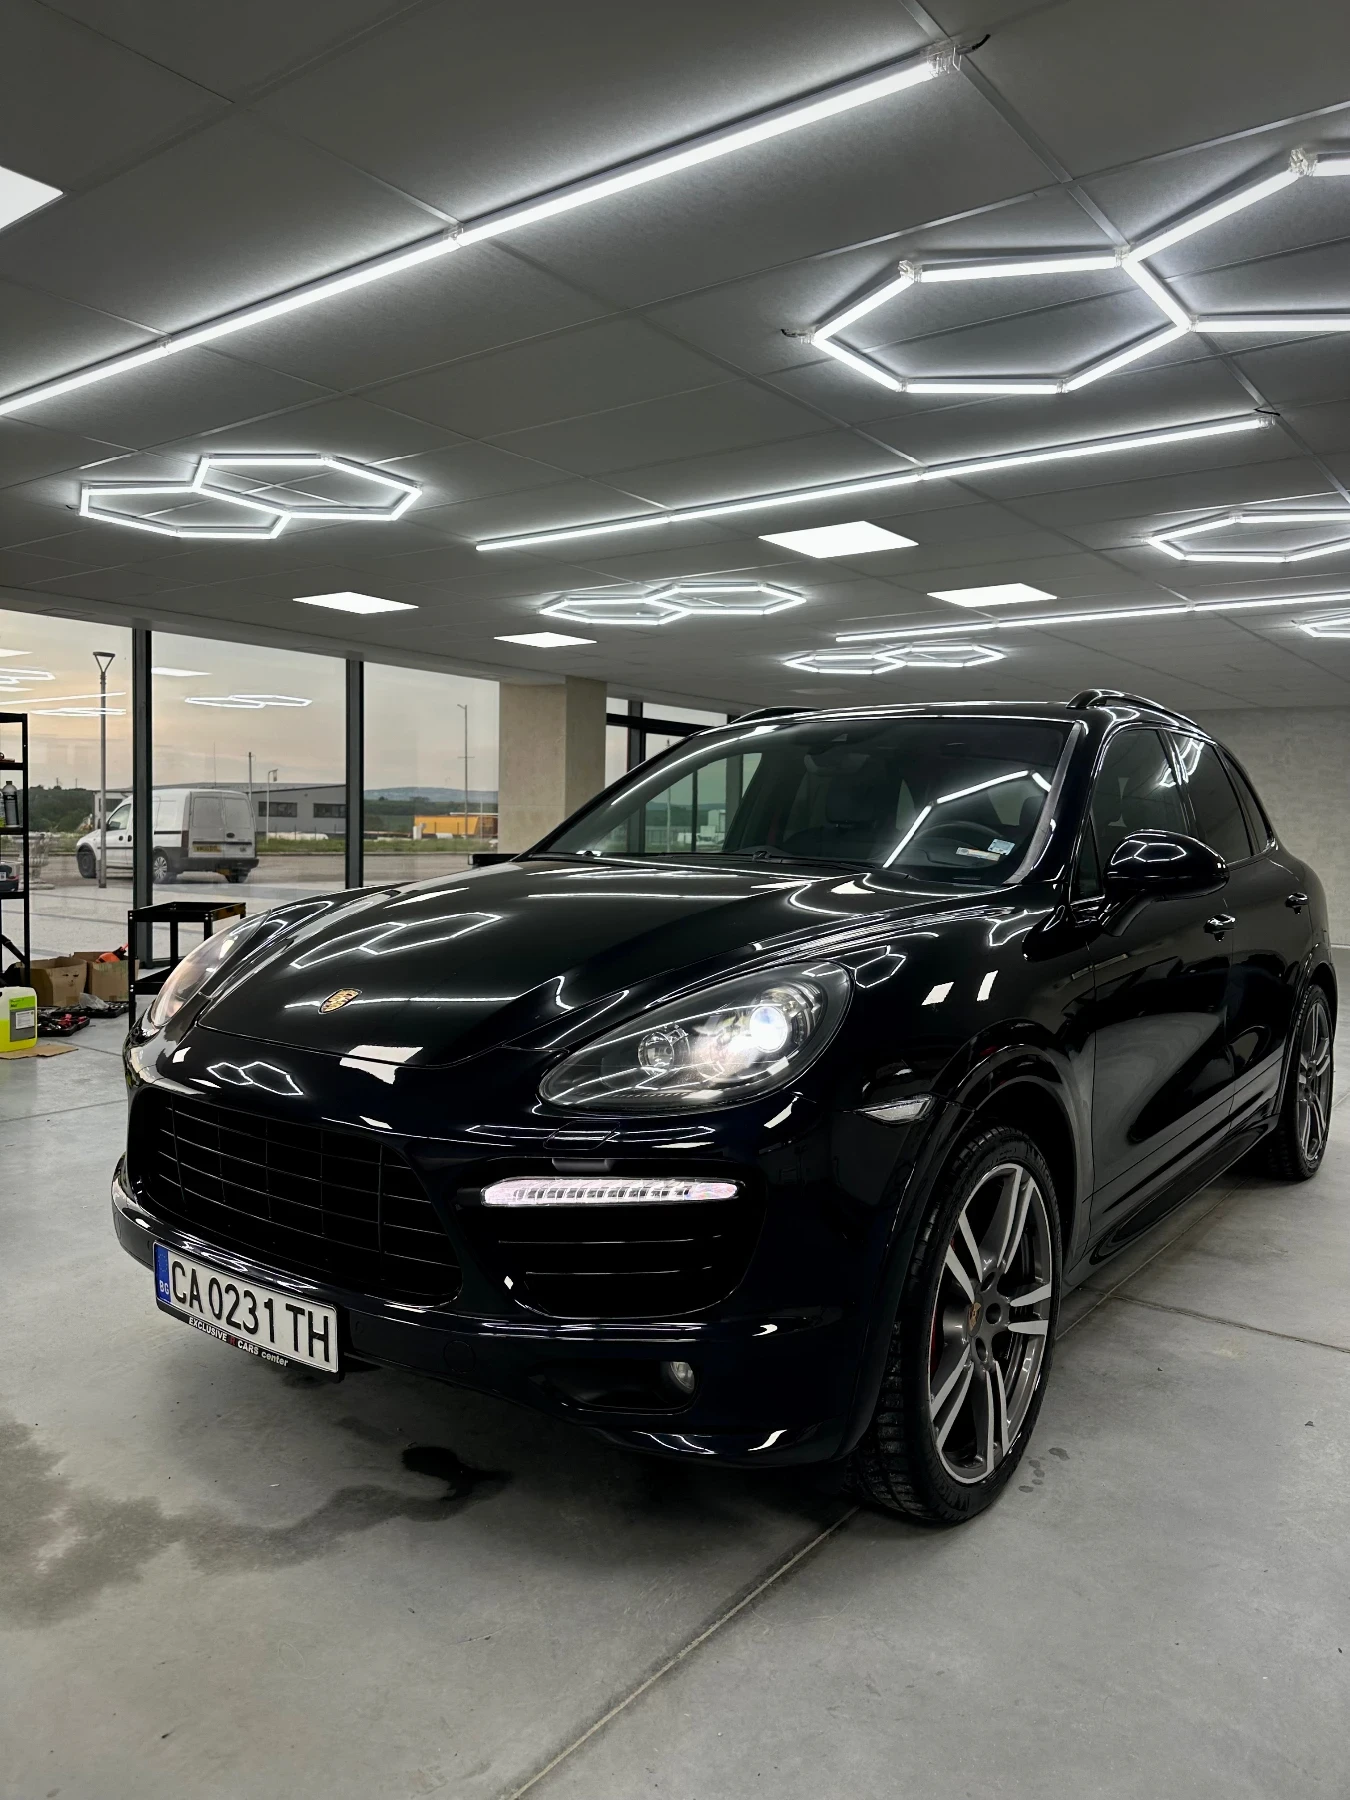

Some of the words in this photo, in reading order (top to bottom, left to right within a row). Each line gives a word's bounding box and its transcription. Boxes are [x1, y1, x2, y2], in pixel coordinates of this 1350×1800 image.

[159, 1279, 170, 1295] BG
[171, 1259, 204, 1314] CA
[208, 1275, 275, 1344] 0231
[285, 1302, 330, 1363] TH
[188, 1316, 228, 1342] EXCLUSIVE
[237, 1340, 259, 1355] CARS
[261, 1350, 289, 1367] center
